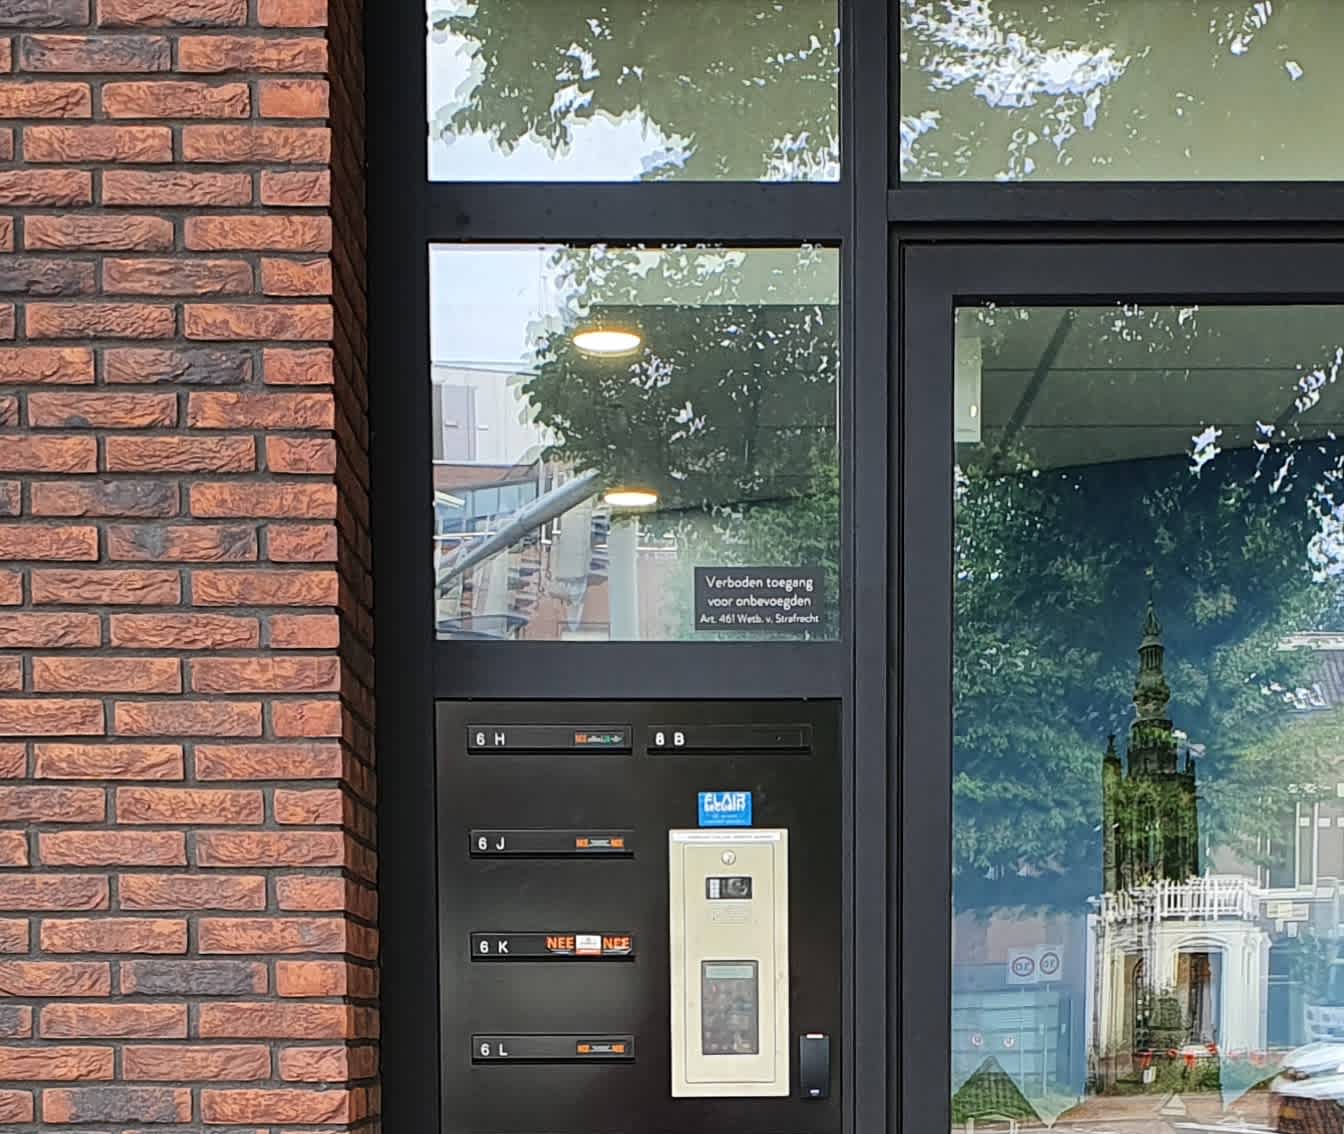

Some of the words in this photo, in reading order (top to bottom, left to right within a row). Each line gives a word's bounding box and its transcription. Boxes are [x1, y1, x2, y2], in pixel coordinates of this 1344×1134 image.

[705, 575, 763, 588] Verboden
[767, 577, 814, 592] toegang
[707, 597, 733, 607] voor
[735, 594, 812, 610] onbevoegden
[718, 613, 735, 624] 461
[775, 613, 820, 624] Strafrecht
[476, 732, 486, 746] 6
[494, 732, 505, 746] H
[655, 731, 665, 746] 8
[673, 731, 685, 746] B
[478, 836, 488, 850] 6
[495, 836, 505, 850] J
[479, 940, 489, 954] 6
[498, 940, 509, 954] K
[546, 936, 574, 949] NEE
[602, 936, 630, 949] NEE
[480, 1042, 490, 1057] 6
[498, 1043, 508, 1057] L
